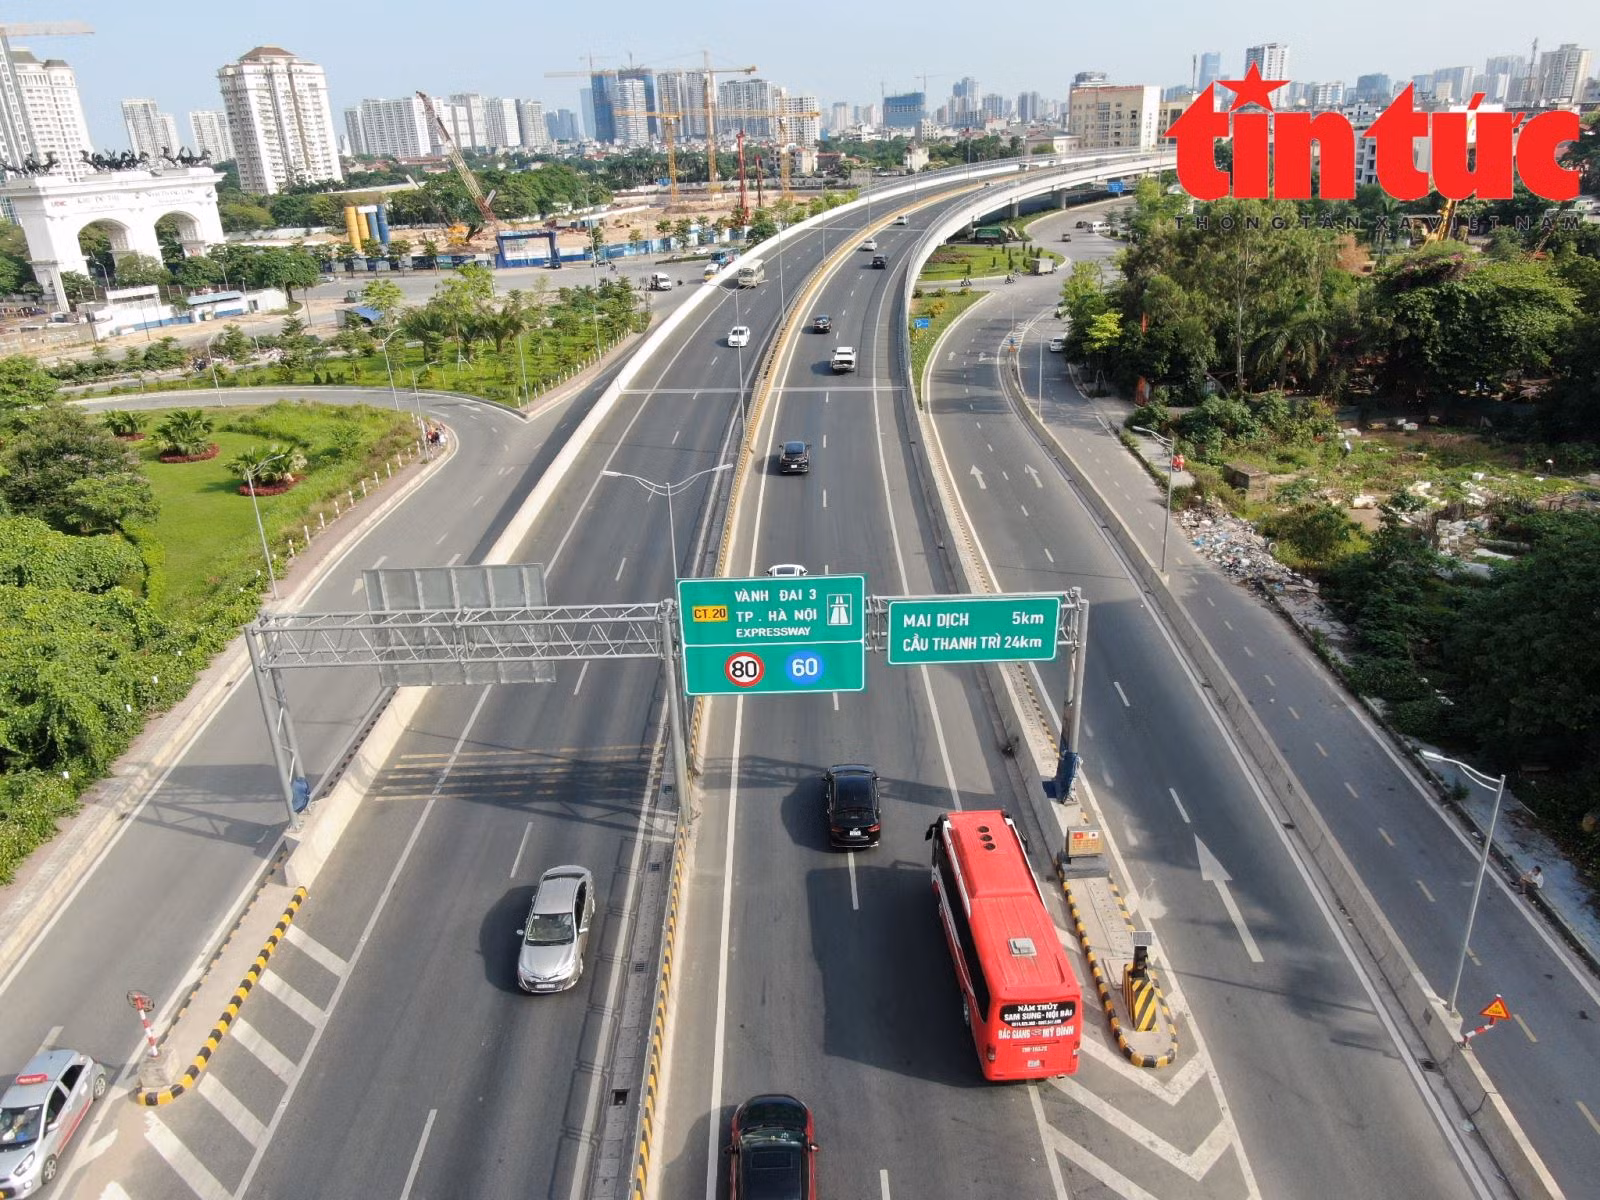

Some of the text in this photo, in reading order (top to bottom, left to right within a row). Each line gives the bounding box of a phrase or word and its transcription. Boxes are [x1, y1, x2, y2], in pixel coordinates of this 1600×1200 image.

[734, 588, 817, 603] VÀNH ĐAI 3
[693, 607, 727, 620] CT.20
[768, 607, 788, 622] HÀ
[794, 608, 818, 623] NỘI
[903, 611, 1044, 629] MAI DỊCH 5km
[736, 626, 812, 638] EXPRESSWAY
[932, 636, 977, 651] THANH
[980, 632, 1001, 649] TRÌ
[1004, 635, 1042, 648] 24km
[731, 660, 759, 679] 80
[792, 658, 818, 677] 60
[1004, 1013, 1020, 1021] SAM
[1046, 1010, 1058, 1019] NỘI
